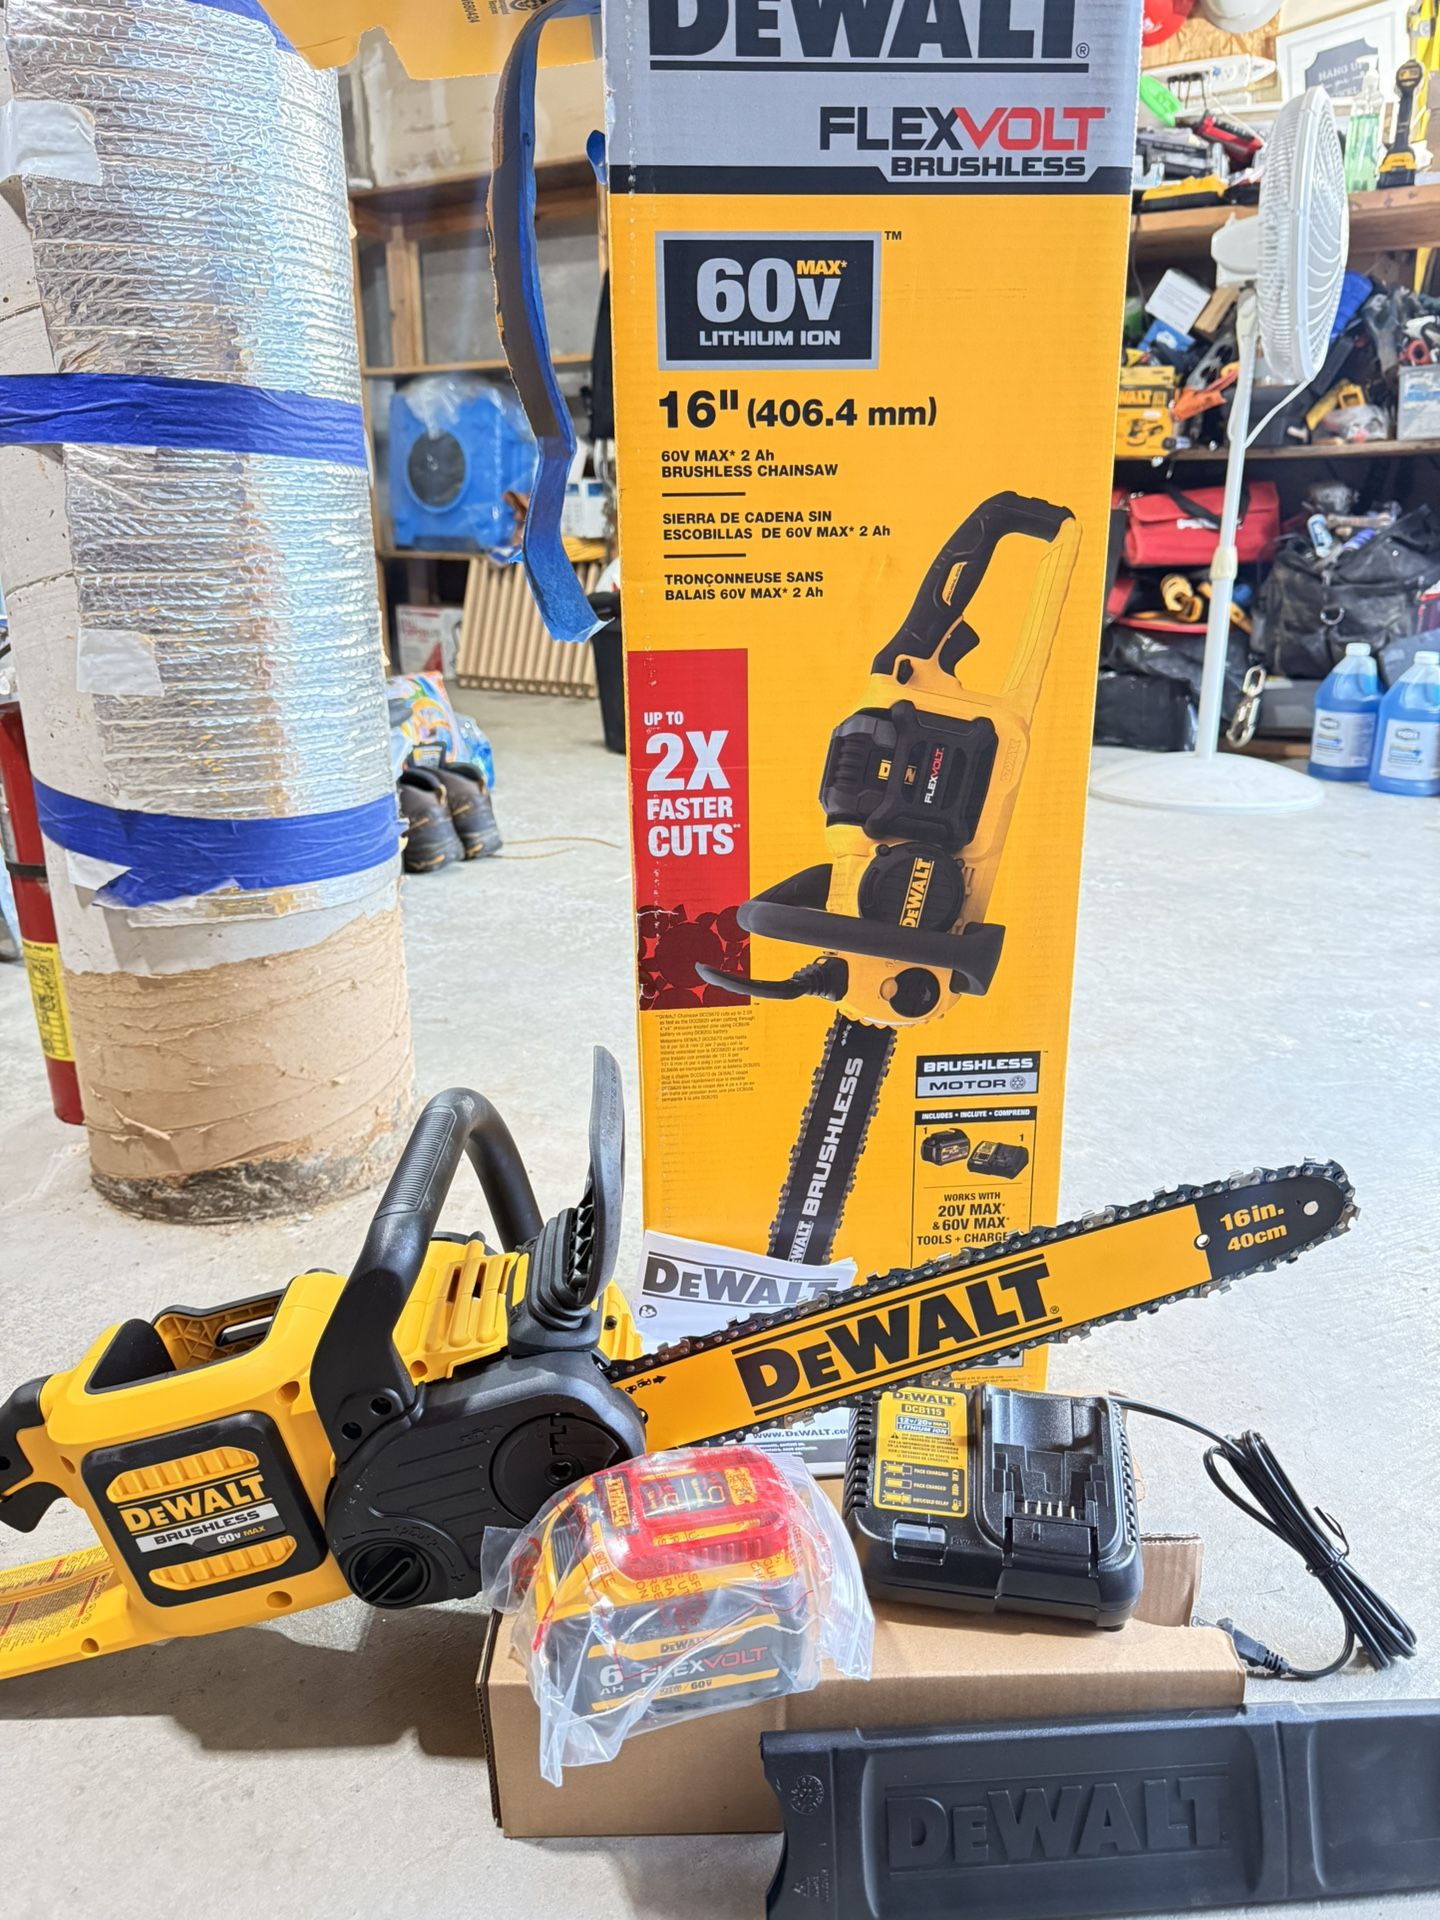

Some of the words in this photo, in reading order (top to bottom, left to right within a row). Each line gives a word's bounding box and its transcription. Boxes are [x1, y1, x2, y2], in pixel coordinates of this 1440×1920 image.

[650, 0, 1075, 58] DEWALT
[819, 107, 1107, 151] FLEXVOLT
[891, 157, 1086, 177] BRUSHLESS
[699, 330, 794, 346] LITHIUM
[800, 330, 841, 346] ION
[659, 389, 739, 429] 16"
[747, 396, 858, 428] (406.4
[868, 397, 938, 428] mm)
[661, 450, 690, 462] 60V
[741, 450, 750, 461] 2
[755, 449, 775, 461] Ah
[661, 465, 752, 478] BRUSHLESS
[757, 464, 838, 477] CHAINSAW
[663, 513, 715, 525] SIERRA
[720, 512, 740, 524] DE
[744, 511, 804, 523] CADENA
[808, 511, 832, 522] SIN
[663, 528, 753, 541] ESCOBILLAS
[761, 527, 781, 539] DE
[786, 527, 812, 538] 60V
[859, 526, 868, 537] 2
[872, 525, 891, 537] Ah
[664, 572, 782, 587] TRONÇONNEUSE
[786, 571, 824, 583] SANS
[665, 588, 716, 601] BALAIS
[720, 588, 746, 600] 60V
[792, 587, 801, 598] 2
[805, 586, 824, 598] Ah
[644, 711, 663, 726] UP
[666, 711, 685, 725] TO
[645, 730, 731, 792] 2X
[924, 747, 945, 804] FLEXVOLT
[646, 796, 733, 821] FASTER
[901, 857, 932, 929] DEWALT
[923, 1058, 1034, 1073] BRUSHLESS
[929, 1080, 1006, 1091] MOTOR
[921, 1111, 953, 1120] INCLUDES
[960, 1110, 987, 1119] INCLUYE
[994, 1109, 1031, 1118] COMPREND
[802, 1057, 864, 1217] BRUSHLESS
[944, 1193, 976, 1202] WORKS
[978, 1192, 1001, 1200] WITH
[938, 1204, 966, 1217] 20V
[932, 1222, 940, 1230] &
[942, 1218, 969, 1231] 60V
[917, 1234, 952, 1245] TOOLS
[964, 1232, 1009, 1243] CHARGE
[1227, 1224, 1288, 1251] 40cm
[643, 1256, 838, 1304] DEWALT
[735, 1267, 1052, 1406] DEWALT
[893, 1391, 955, 1406] DEWALT
[904, 1404, 943, 1416] DCB115
[120, 1474, 265, 1533] DEWALT
[153, 1510, 261, 1545] BRUSHLESS
[243, 1525, 266, 1538] MAX
[600, 1665, 624, 1686] 6
[640, 1647, 768, 1684] FLEXVOLT
[600, 1685, 625, 1696] AH
[888, 1777, 1230, 1868] DEWALT
